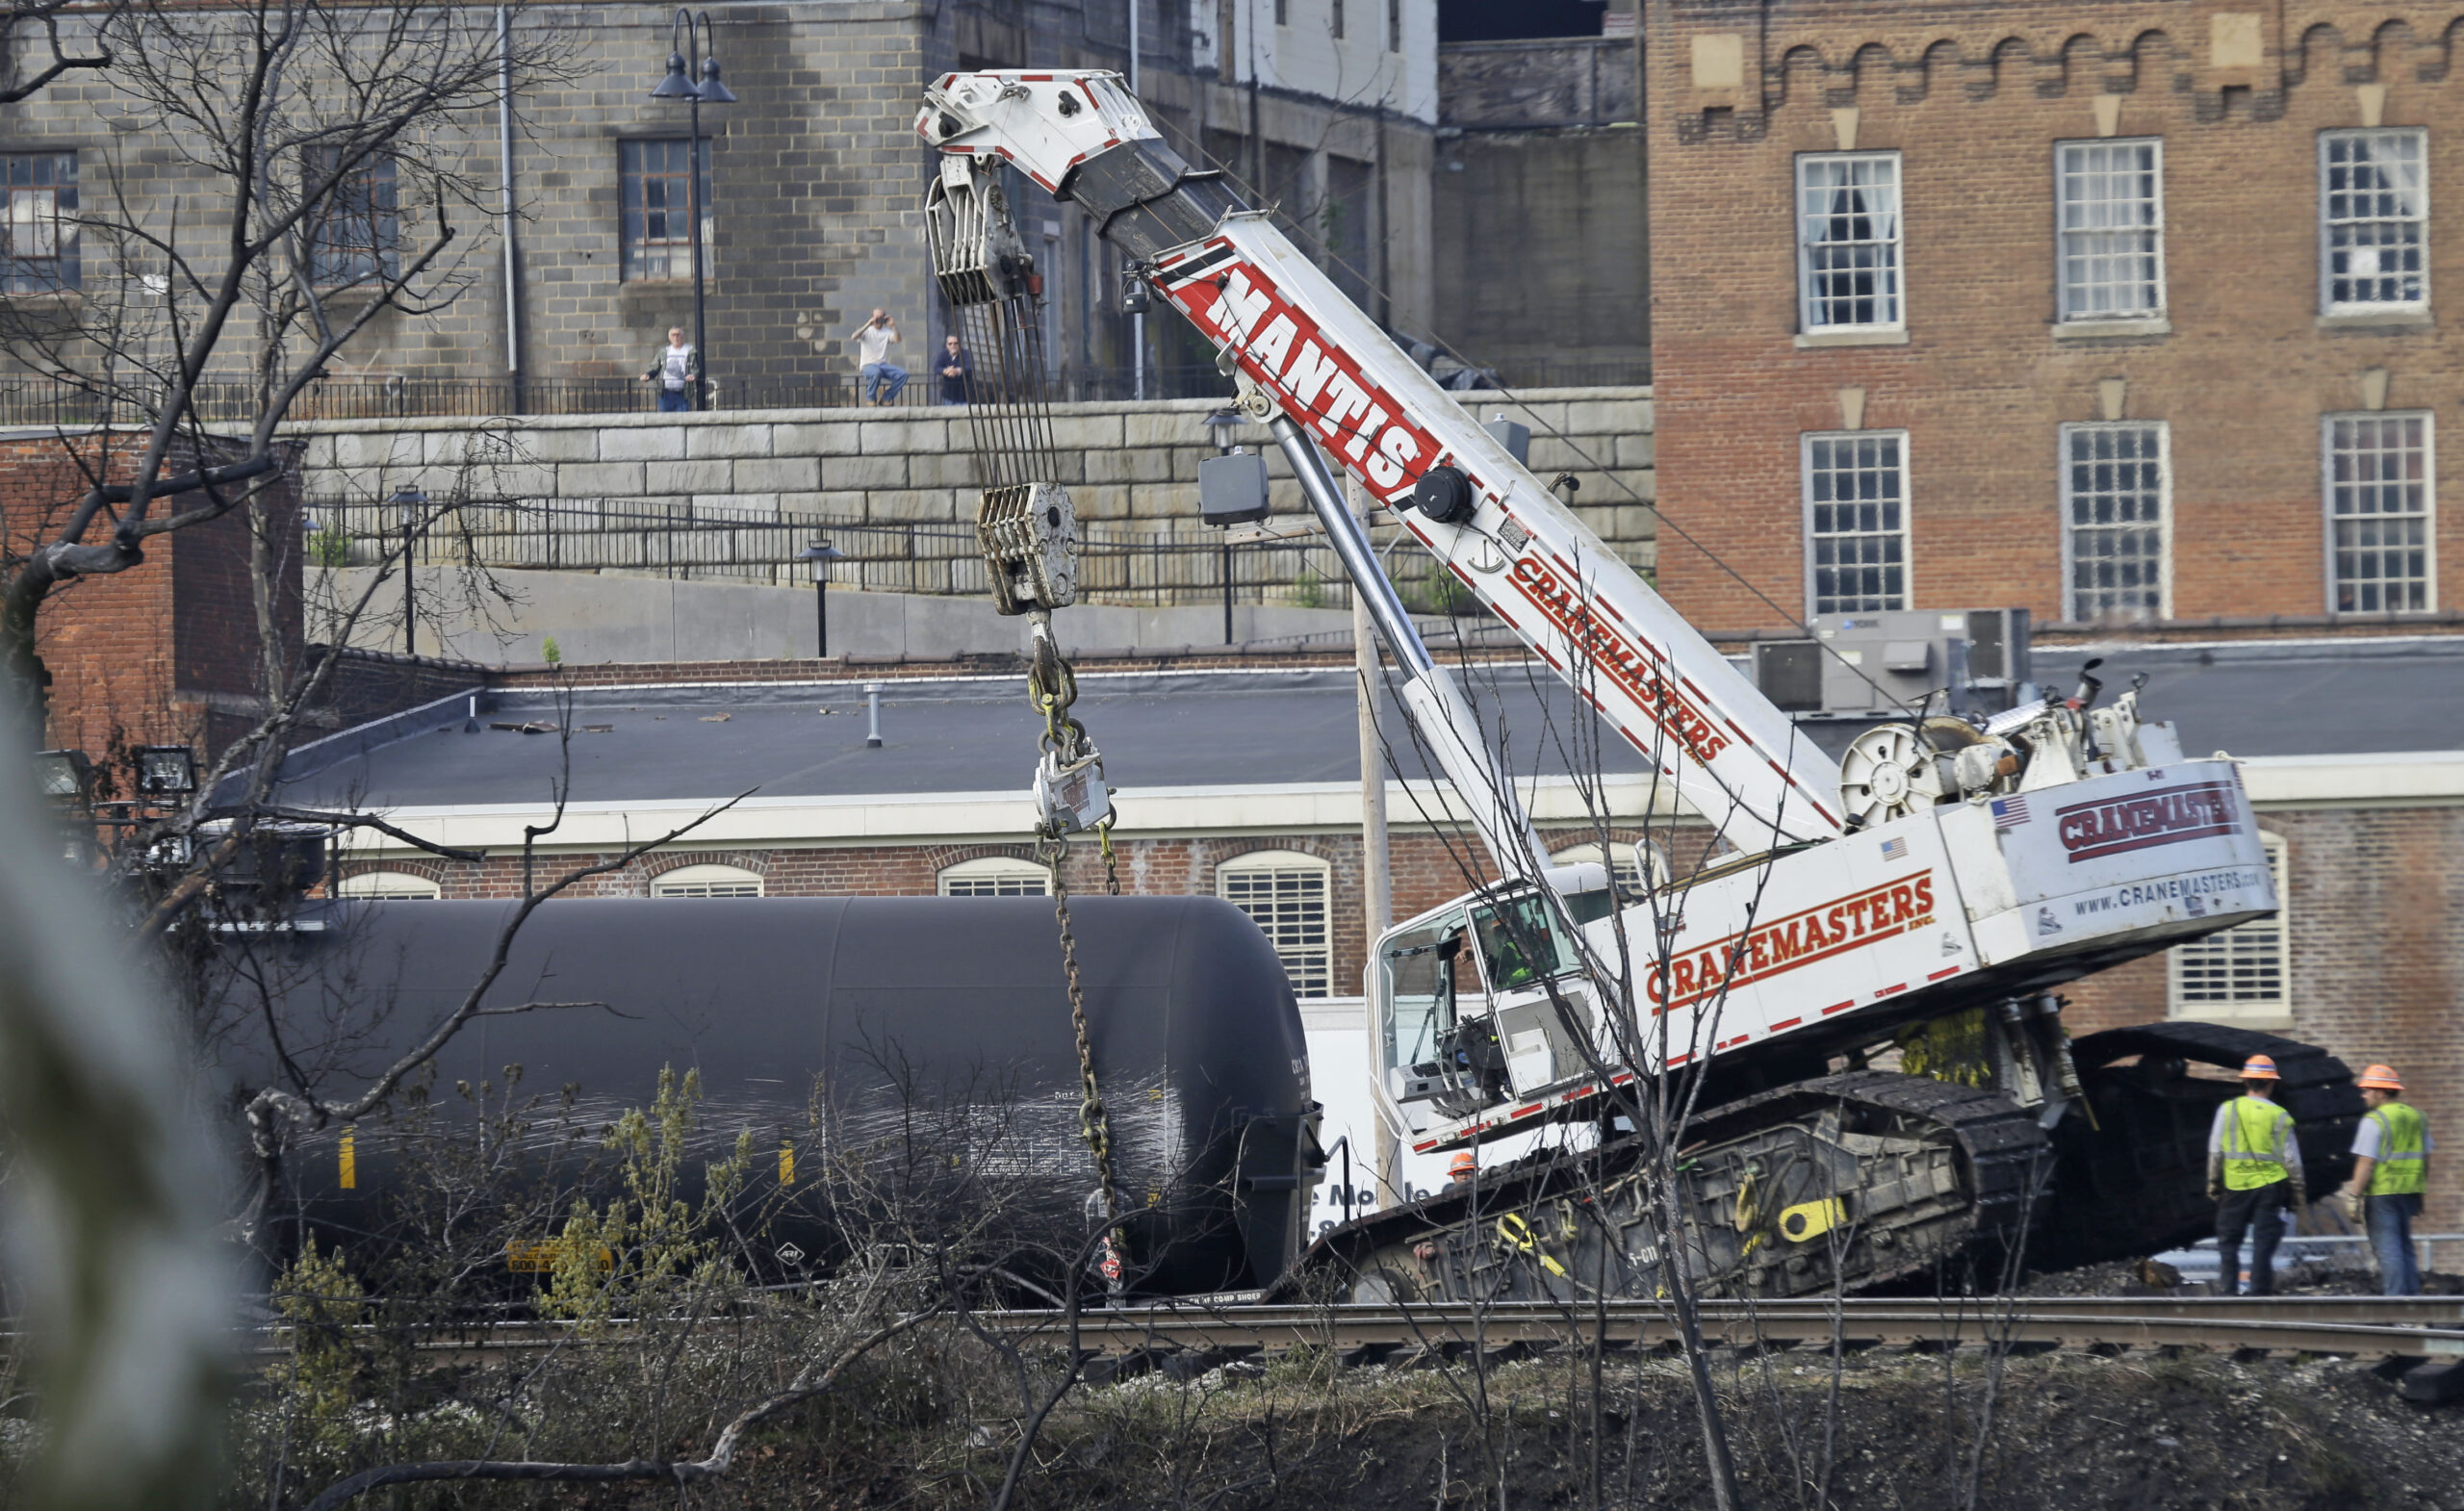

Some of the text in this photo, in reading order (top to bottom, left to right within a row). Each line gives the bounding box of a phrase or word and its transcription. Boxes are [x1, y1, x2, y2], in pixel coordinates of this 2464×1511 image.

[1205, 268, 1420, 489] MANTIS
[1647, 876, 1935, 1004] CRANEMASTERS
[1329, 1182, 1431, 1206] Mole
[1214, 1294, 1235, 1303] COMP
[1237, 1293, 1261, 1301] SHOES
